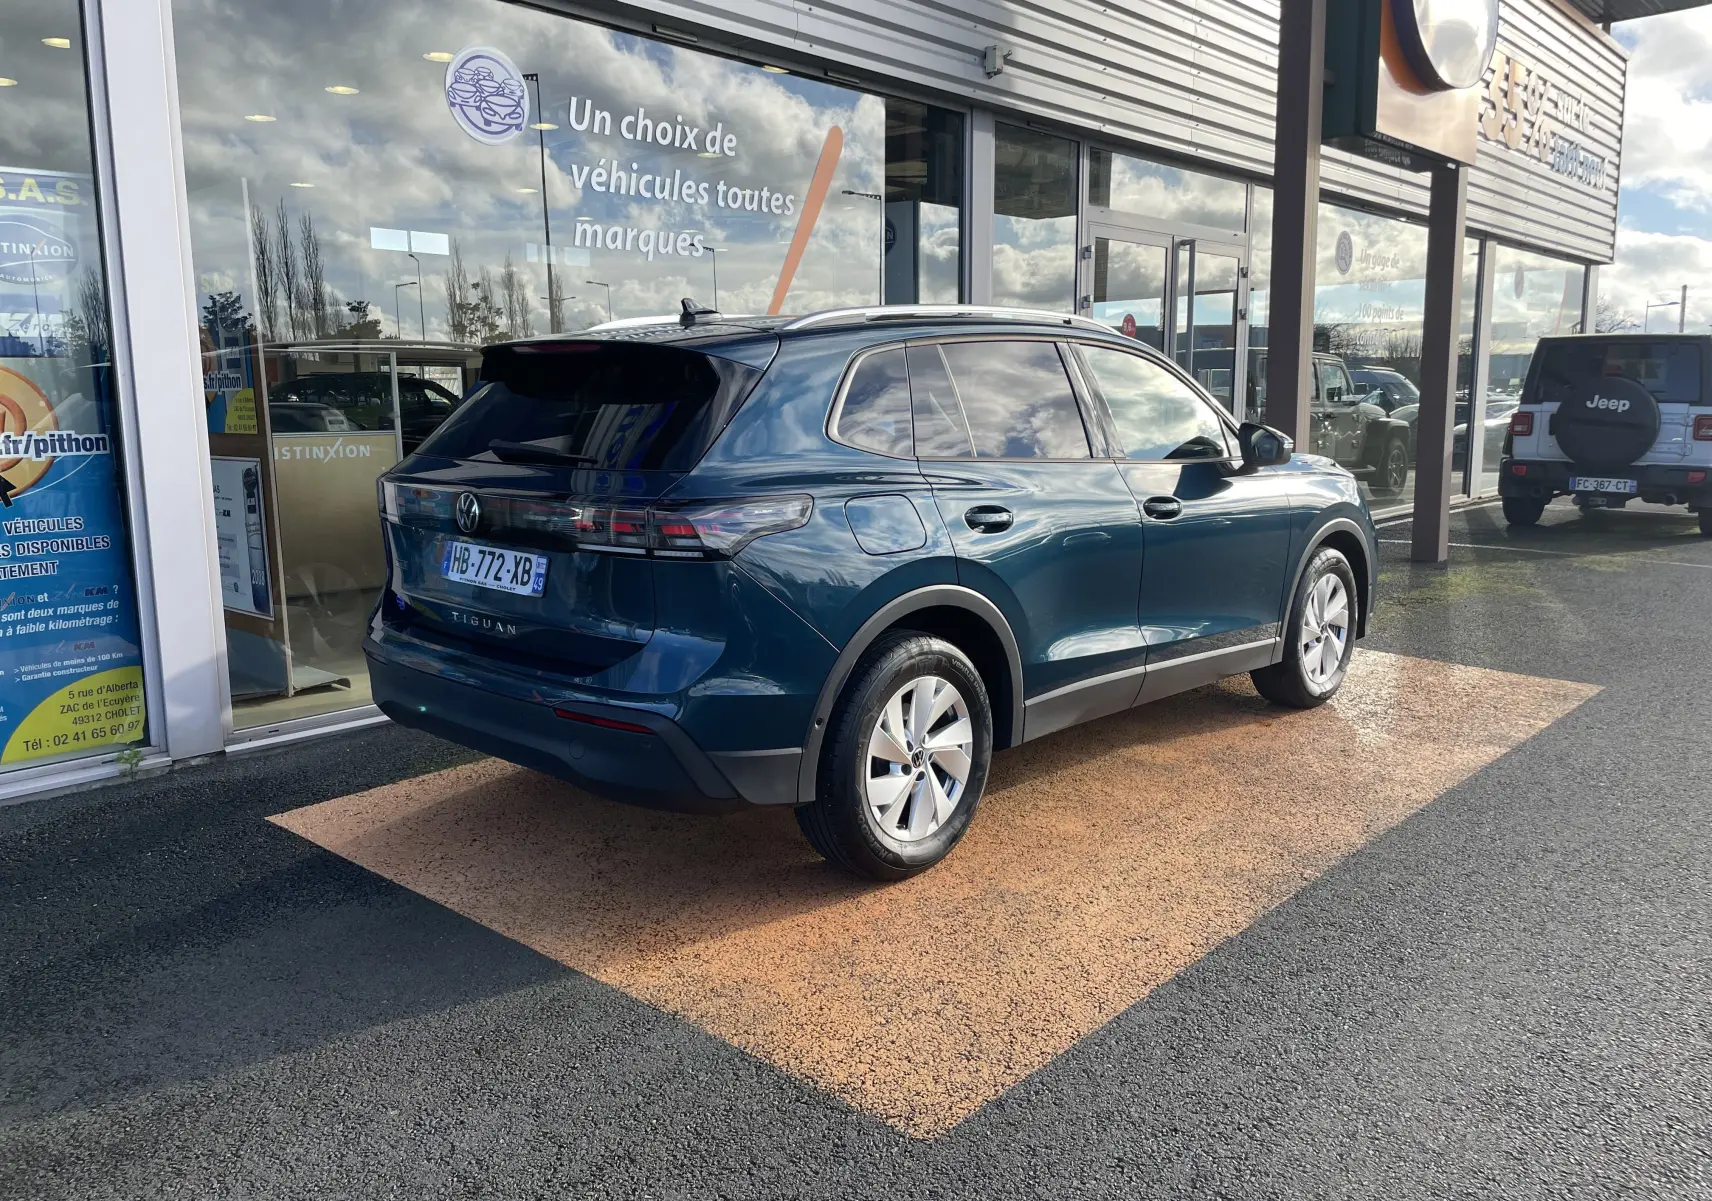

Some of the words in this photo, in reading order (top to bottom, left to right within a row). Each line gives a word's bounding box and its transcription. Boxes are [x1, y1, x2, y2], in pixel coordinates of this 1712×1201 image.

[569, 97, 611, 136] Un
[620, 107, 699, 150] choix
[705, 122, 737, 156] de
[571, 158, 709, 205] véhicules
[716, 180, 795, 216] toutes
[575, 222, 704, 261] marques
[1372, 255, 1389, 271] gage
[1391, 253, 1399, 268] de
[1372, 304, 1394, 323] points
[1586, 395, 1631, 412] Jeep
[1576, 479, 1629, 491] FC-367-CT
[3, 517, 83, 534] VÉHICULES
[16, 536, 110, 556] DISPONIBLES
[0, 561, 58, 579] TEMENT
[451, 545, 532, 586] HB-772-XB
[37, 592, 48, 602] et
[112, 584, 118, 595] ?
[533, 577, 544, 591] 49
[2, 610, 26, 622] sont
[27, 609, 54, 620] deux
[57, 602, 104, 614] marques
[107, 600, 119, 609] de
[6, 626, 12, 637] à
[16, 622, 46, 635] faible
[452, 611, 516, 634] TIGUAN
[20, 662, 52, 672] Véhicules
[63, 657, 85, 666] moins
[22, 672, 51, 682] Garantie
[53, 665, 98, 677] constructeur
[68, 691, 75, 700] 5
[78, 688, 94, 698] rue
[97, 681, 139, 695] d'Alberta
[60, 703, 80, 715] ZAC
[82, 701, 94, 711] de
[97, 694, 140, 709] l'Ecuyère
[72, 713, 102, 726] 49312
[104, 705, 141, 720] CHOLET
[23, 738, 43, 752] Tél
[53, 733, 69, 746] 02
[72, 731, 87, 743] 41
[91, 727, 107, 739] 65
[110, 723, 125, 736] 60
[127, 720, 140, 732] 97
